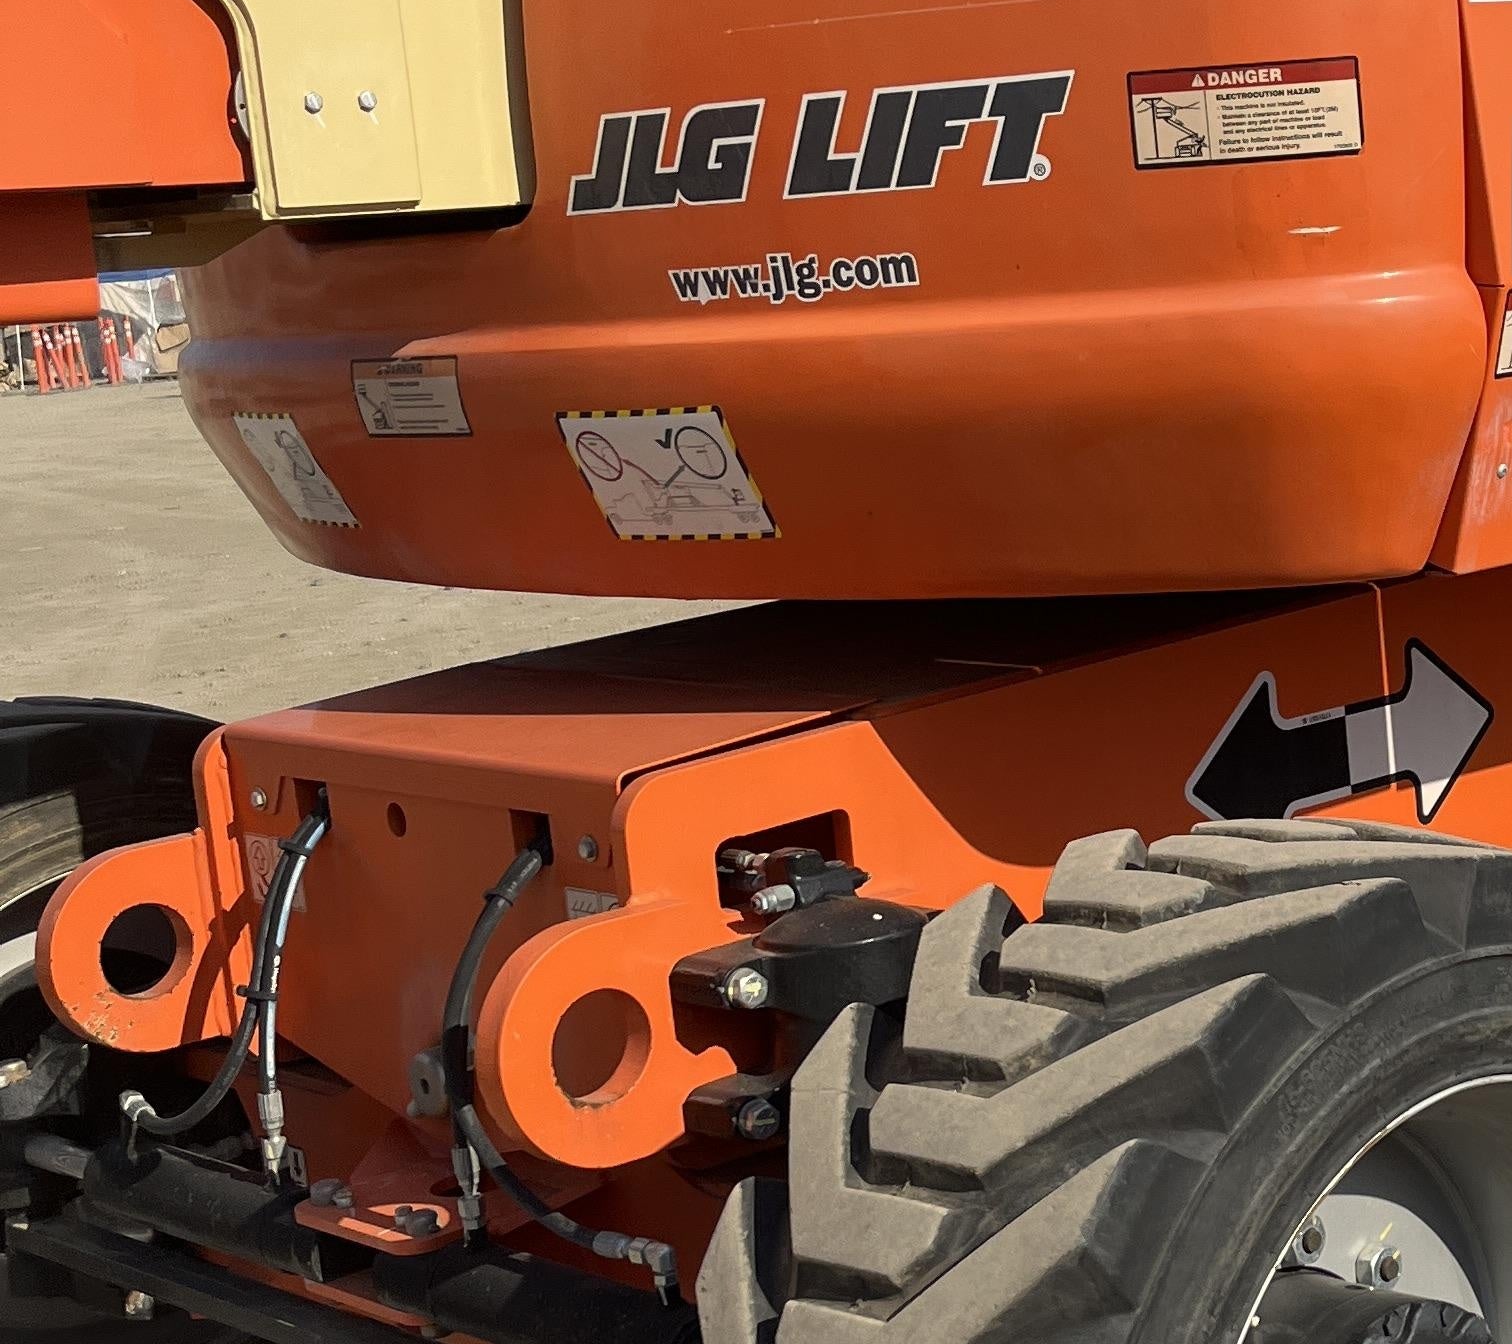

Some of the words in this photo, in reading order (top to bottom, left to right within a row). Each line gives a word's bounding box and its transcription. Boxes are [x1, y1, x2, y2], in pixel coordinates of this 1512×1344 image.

[1207, 67, 1283, 87] DANGER
[1216, 89, 1284, 101] ELECTROCUTION
[1286, 86, 1320, 95] HAZARD
[568, 100, 765, 215] JLG
[670, 251, 920, 304] www.jlg.com
